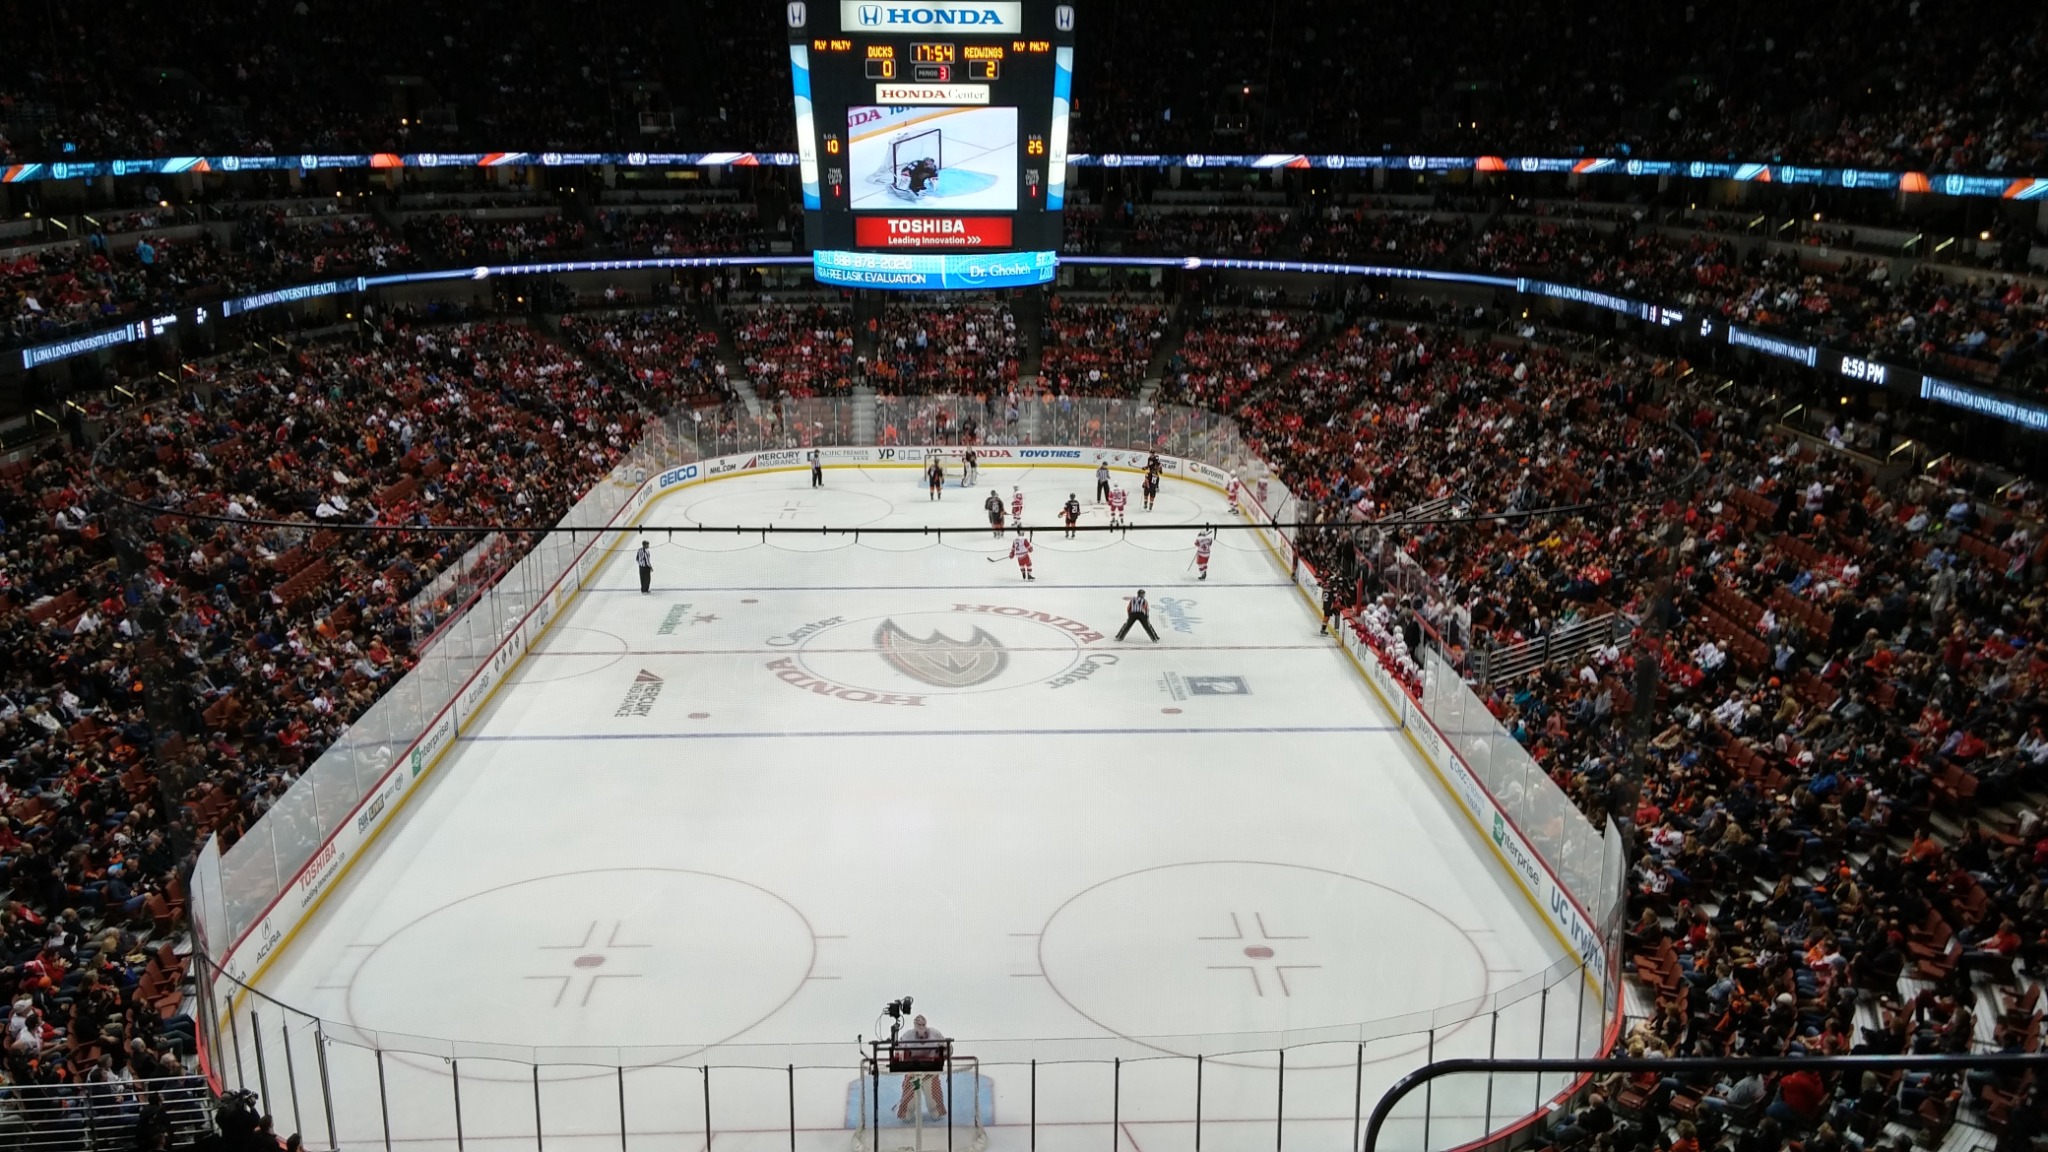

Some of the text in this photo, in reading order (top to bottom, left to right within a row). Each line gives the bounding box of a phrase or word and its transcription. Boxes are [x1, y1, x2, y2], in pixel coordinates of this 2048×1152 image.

[887, 8, 1003, 25] HONDA
[814, 40, 851, 50] PLY PNLTY
[868, 46, 893, 57] DUCKS
[917, 45, 953, 62] 17:54
[964, 46, 1003, 59] REDWINGS
[1013, 41, 1049, 51] PLY PNLTY
[882, 61, 892, 77] 0
[939, 66, 947, 80] 3
[986, 61, 996, 78] 2
[881, 88, 985, 99] HONDA Center
[827, 140, 839, 153] 10
[1028, 141, 1043, 155] 25
[888, 220, 965, 233] TOSHIBA
[888, 236, 965, 246] Leading Innovation
[501, 258, 722, 275] ANAHEIM DUCKS HOCKEY
[970, 265, 987, 277] Dr.
[989, 262, 1031, 277] Ghosheh
[1213, 259, 1421, 279] ANAHEIM DUCKS HOCKEY
[842, 271, 864, 281] LASIK
[864, 273, 926, 284] EVALUATION
[243, 282, 336, 310] LOMA LINDA UNIVERSITY HEALTH
[1545, 283, 1627, 312] LOMA LINDA UNIVERSITY HEALTH
[33, 349, 52, 362] LOMA
[52, 344, 71, 359] LINDA
[71, 335, 104, 353] UNIVERSITY
[104, 329, 126, 343] HEALTH
[1735, 331, 1807, 361] LOMA LINDA UNIVERSITY HEALTH
[1841, 356, 1885, 385] 8:59 PM
[1932, 384, 2048, 428] LOMA LINDA UNIVERSITY HEALTH
[758, 451, 800, 460] MERCURY
[878, 448, 895, 459] yp
[1019, 450, 1081, 458] TOYO TIRES
[710, 464, 736, 475] NHL.COM
[758, 459, 800, 467] INSURANCE
[660, 465, 697, 488] GEICO
[766, 616, 845, 646] Center
[952, 603, 1104, 644] HONDA
[1047, 654, 1119, 689] Center
[767, 657, 927, 706] HONDA
[631, 682, 664, 717] MERCURY
[412, 721, 448, 768] enterprise
[371, 797, 384, 818] LIVE
[1496, 823, 1540, 886] enterprise
[300, 842, 336, 891] TOSHIBA
[302, 862, 338, 908] Leading Innovation
[1551, 885, 1602, 977] UC Irvine
[257, 930, 281, 963] ACURA
